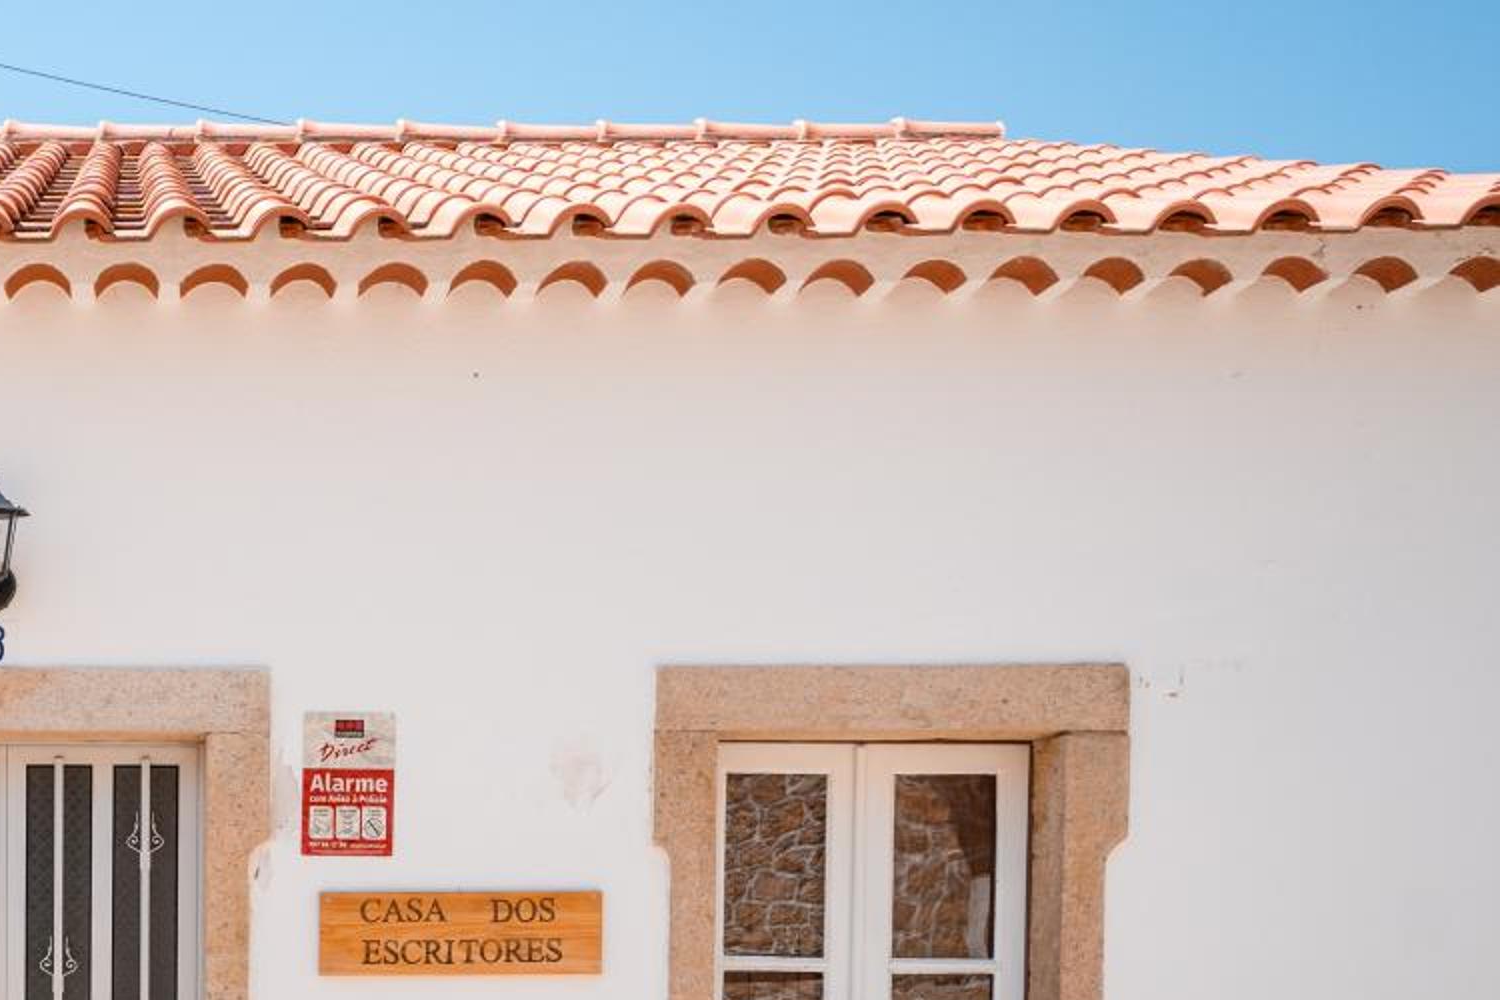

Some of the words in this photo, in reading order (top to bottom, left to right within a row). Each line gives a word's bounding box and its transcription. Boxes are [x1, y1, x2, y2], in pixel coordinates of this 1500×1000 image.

[310, 772, 388, 793] Alarme
[360, 897, 447, 923] CASA
[490, 897, 556, 923] DOS
[361, 937, 564, 966] ESCRITORES
